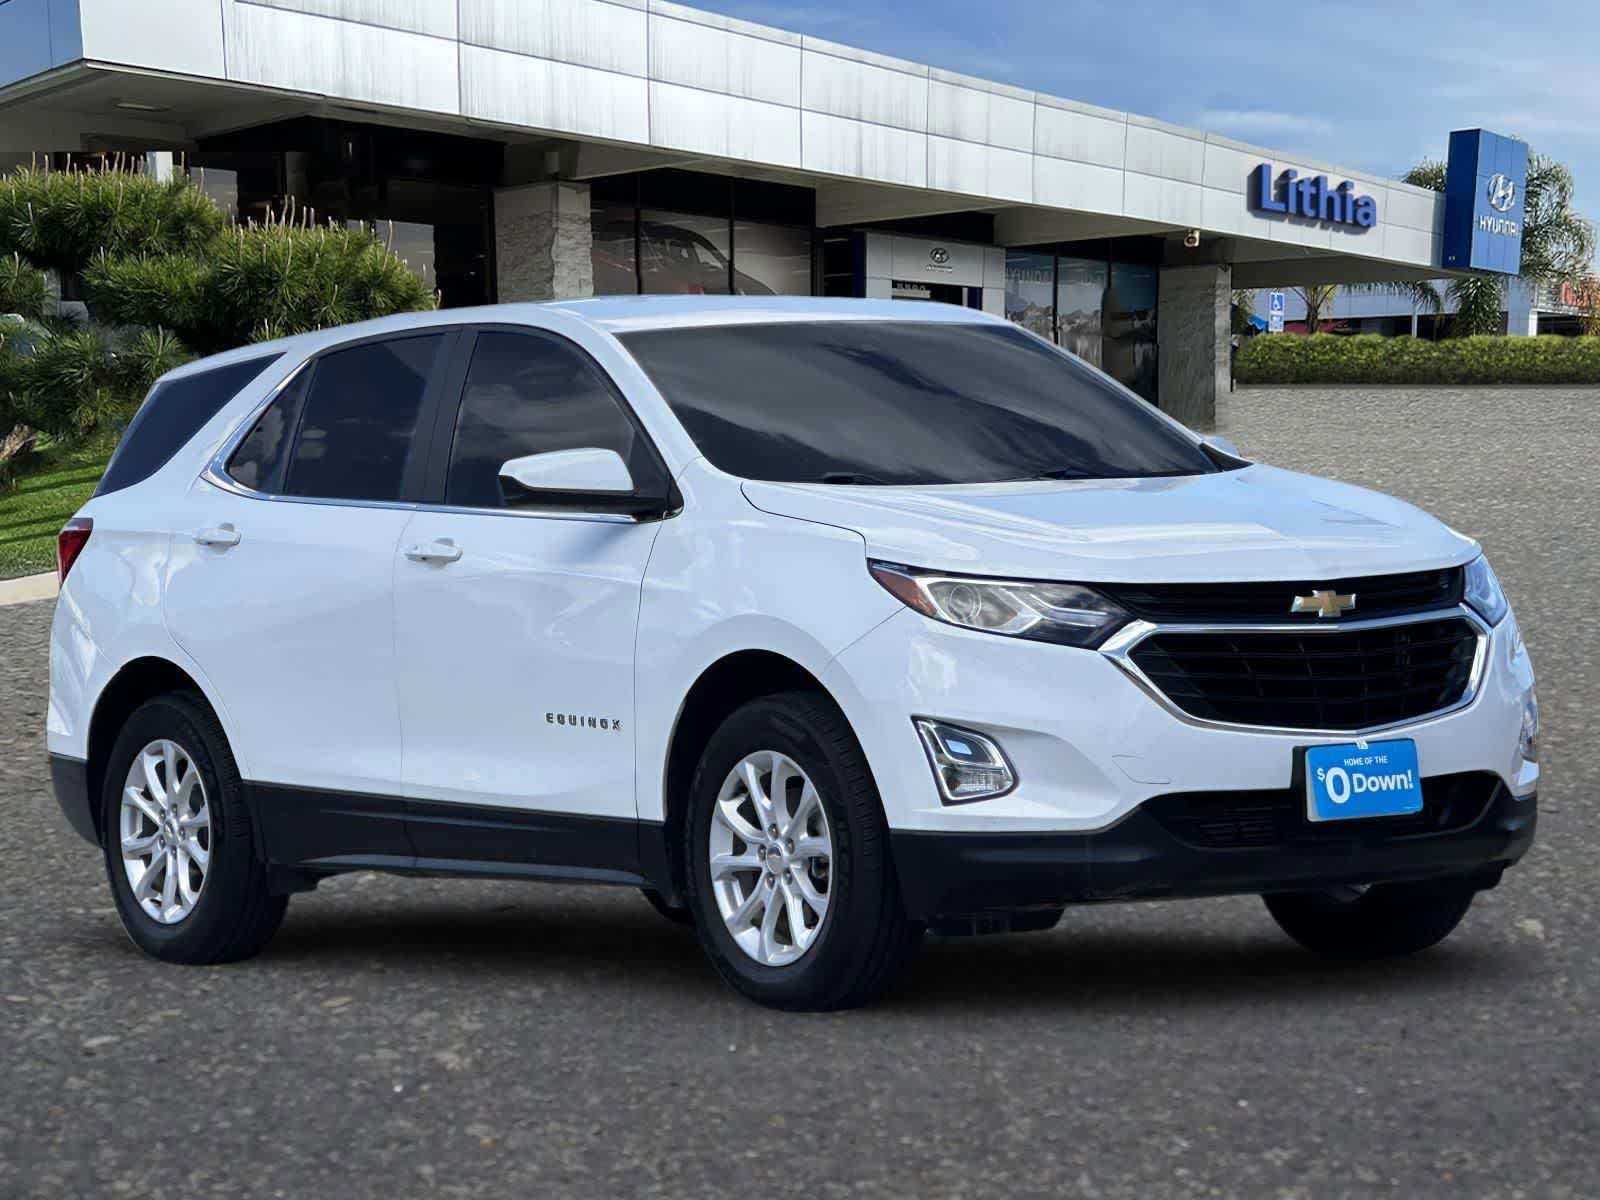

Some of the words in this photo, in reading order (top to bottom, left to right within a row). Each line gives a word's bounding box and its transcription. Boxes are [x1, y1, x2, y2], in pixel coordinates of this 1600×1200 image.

[1256, 163, 1377, 229] Lithia
[1479, 215, 1520, 239] HYUNDAI
[545, 712, 621, 731] EQUINOX
[1343, 758, 1364, 767] HOME
[1364, 756, 1374, 765] OF
[1375, 755, 1389, 764] THE
[1352, 769, 1414, 793] Down!
